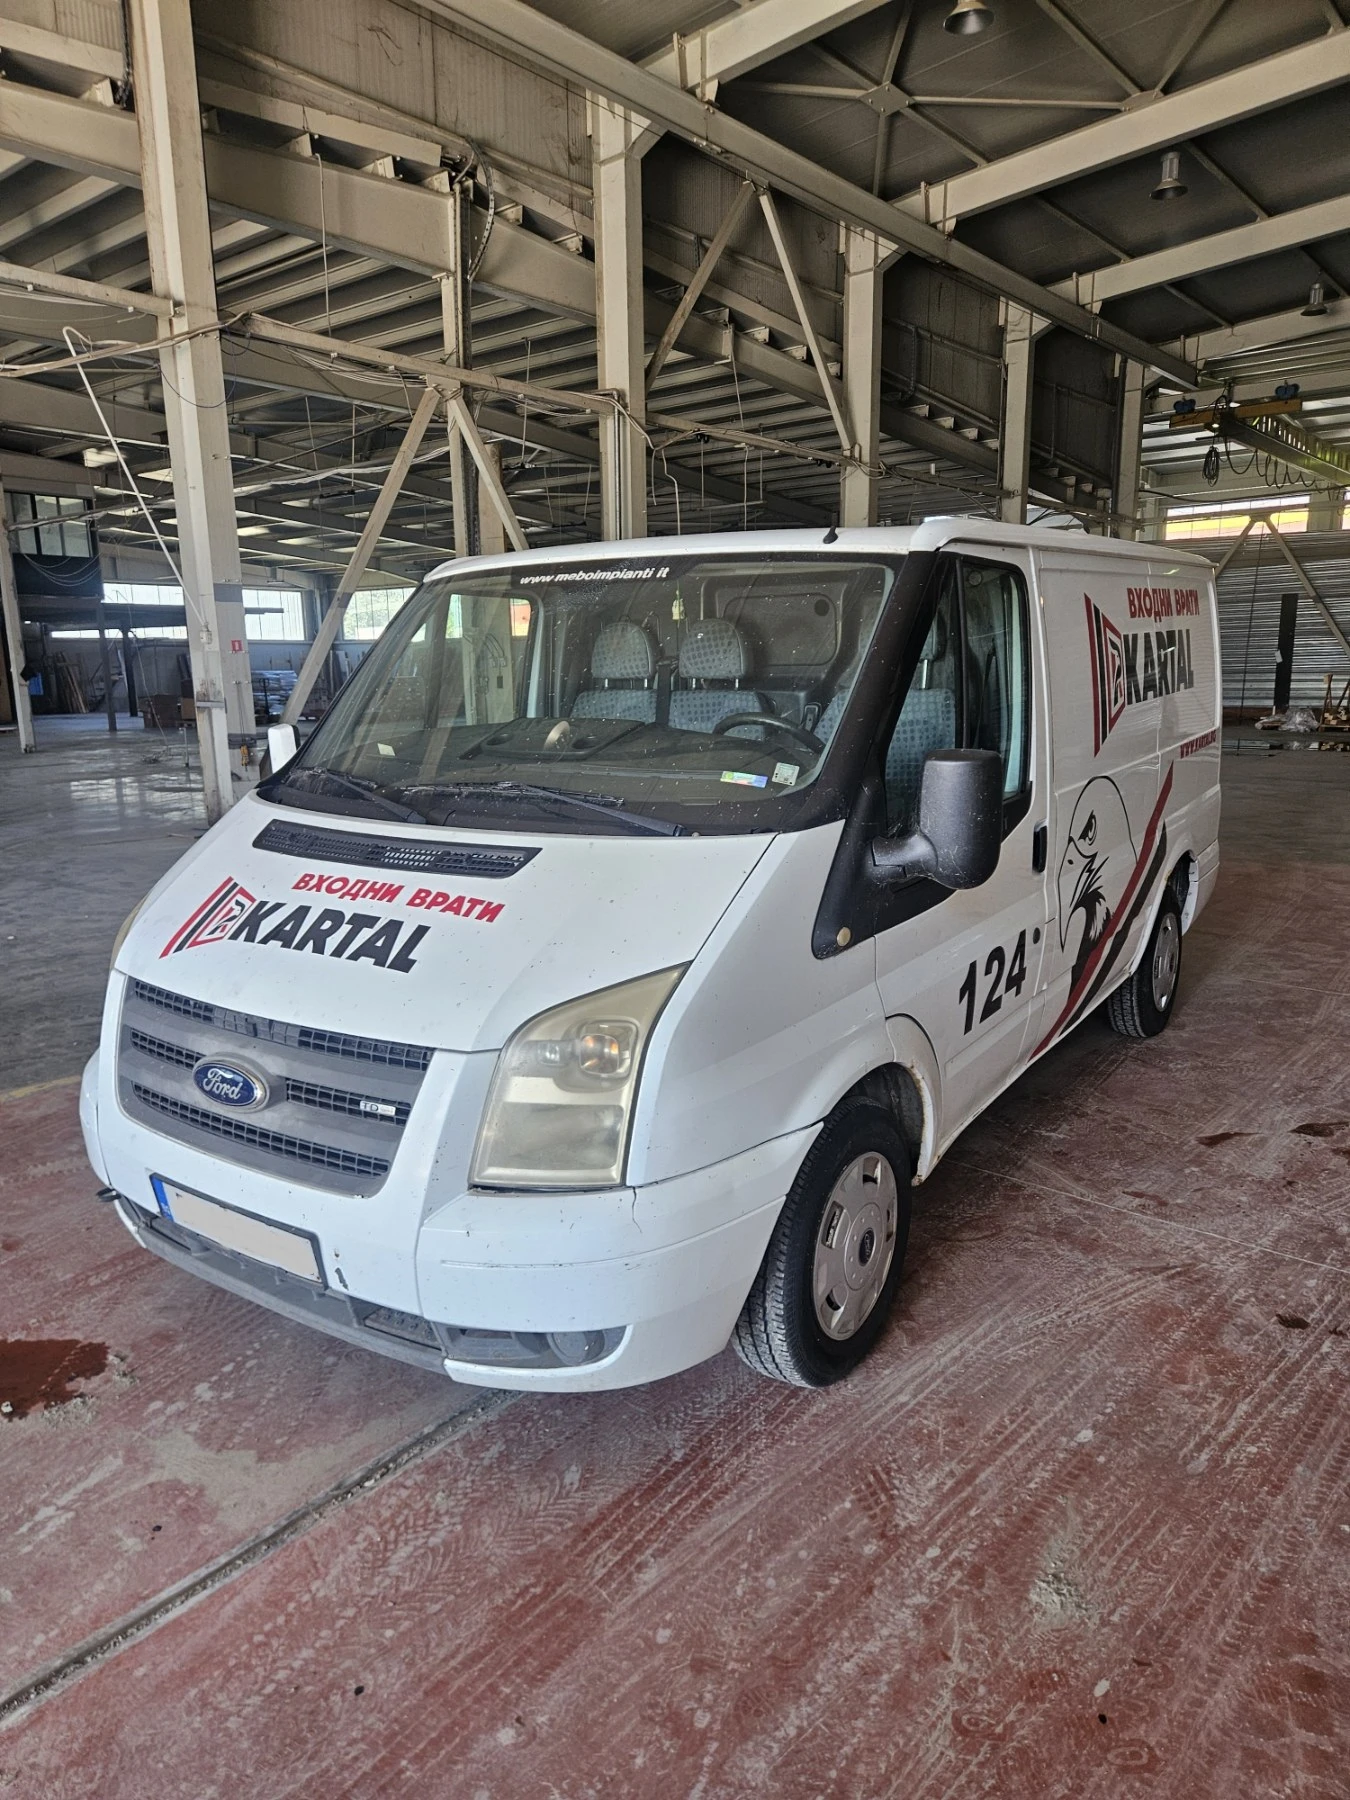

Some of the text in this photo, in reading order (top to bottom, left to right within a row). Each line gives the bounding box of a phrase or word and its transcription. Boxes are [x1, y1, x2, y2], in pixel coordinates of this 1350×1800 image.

[1127, 587, 1200, 623] ВХОДНИ ВРАТИ
[1123, 628, 1194, 706] KARTAL
[291, 873, 505, 923] ВХОДНИ ВРАТИ
[228, 900, 431, 974] KARTAL
[959, 928, 1027, 1036] 124
[202, 1067, 243, 1100] Ford
